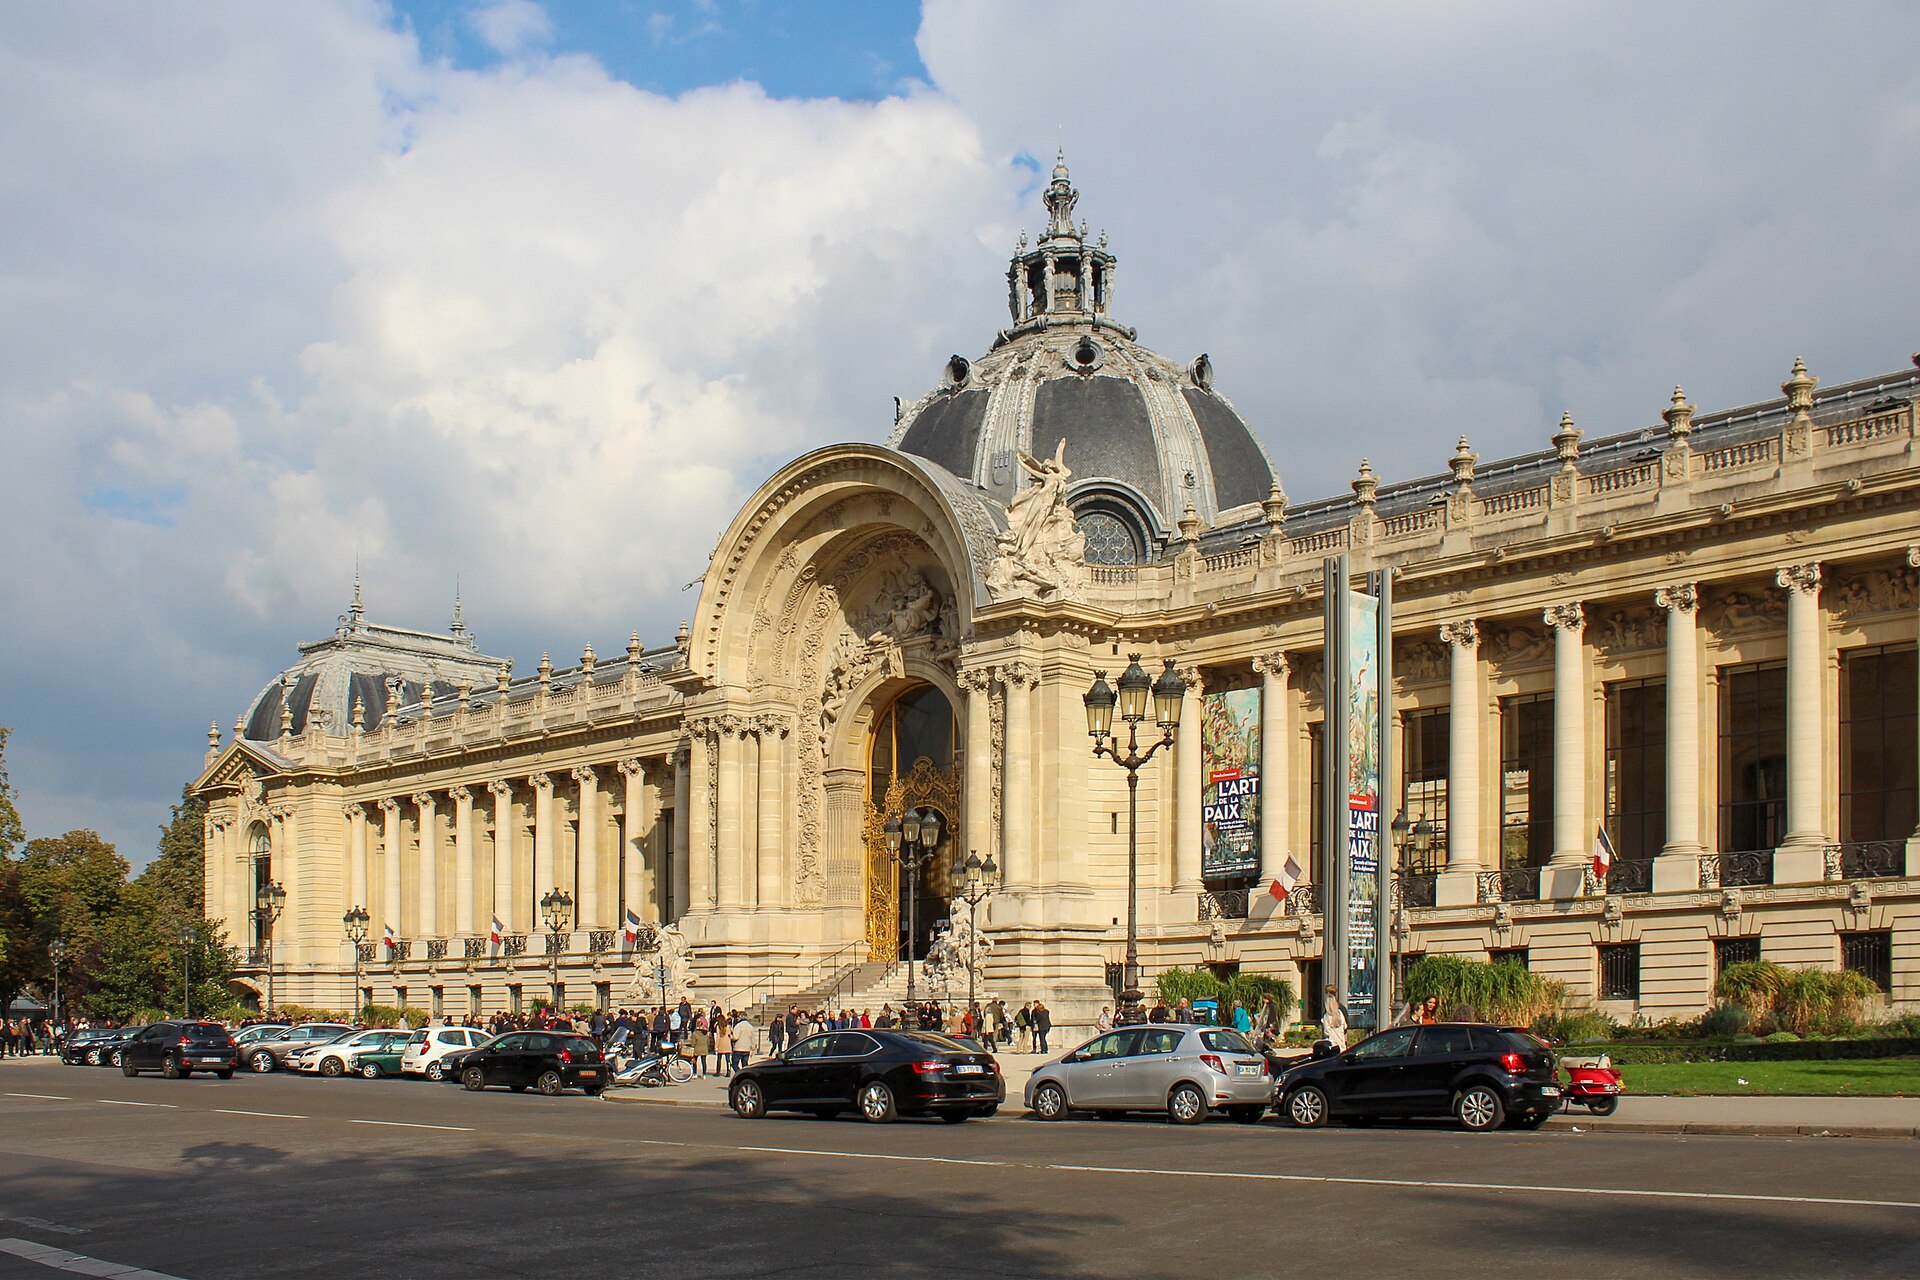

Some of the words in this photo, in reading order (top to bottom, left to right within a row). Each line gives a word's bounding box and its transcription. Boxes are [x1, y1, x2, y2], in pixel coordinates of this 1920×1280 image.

[1218, 777, 1259, 797] L'ART
[1204, 804, 1240, 822] PAIX
[1349, 810, 1378, 831] L'ART
[1357, 831, 1364, 839] LA
[1349, 840, 1370, 859] AIX
